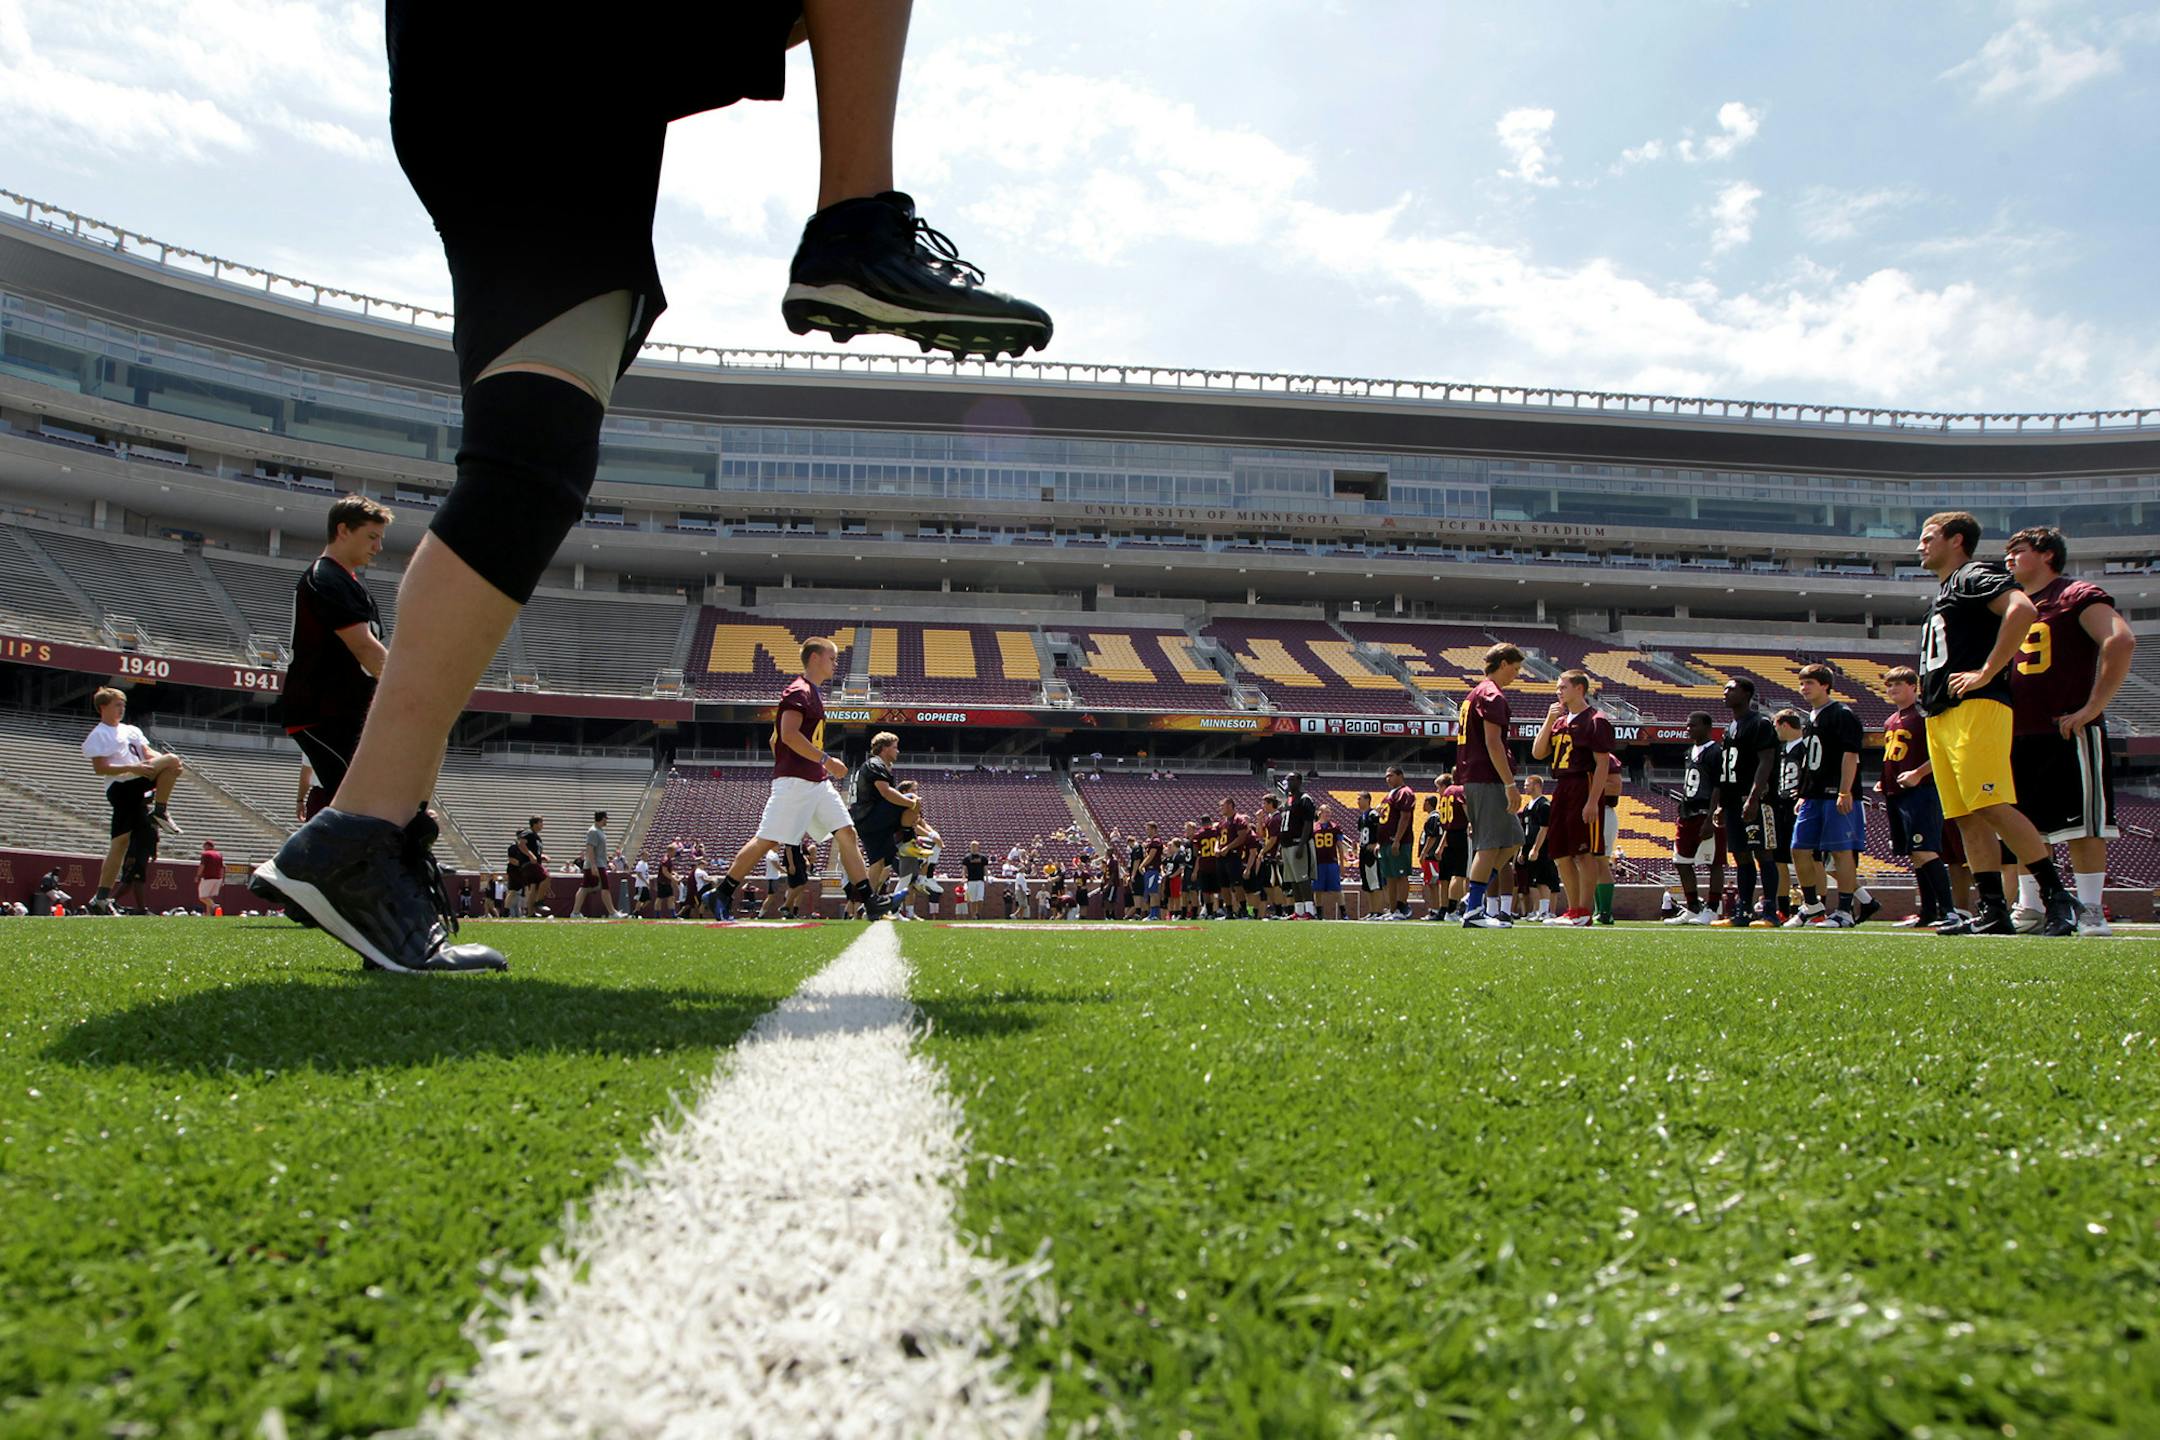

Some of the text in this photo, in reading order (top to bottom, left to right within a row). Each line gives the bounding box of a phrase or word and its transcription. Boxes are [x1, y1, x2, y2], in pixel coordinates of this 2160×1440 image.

[1084, 505, 1341, 525] UNIVERSITY OF MINNESOTA
[1437, 519, 1606, 537] TCF BANK STADIUM
[0, 640, 51, 662] IPS
[119, 655, 170, 678] 1940
[233, 670, 280, 691] 1941
[824, 710, 871, 721] NNESOTA
[916, 712, 967, 722] GOPHERS
[1200, 718, 1258, 729] MINNESOTA
[1657, 730, 1691, 739] GOPHE
[1314, 832, 1334, 848] 68
